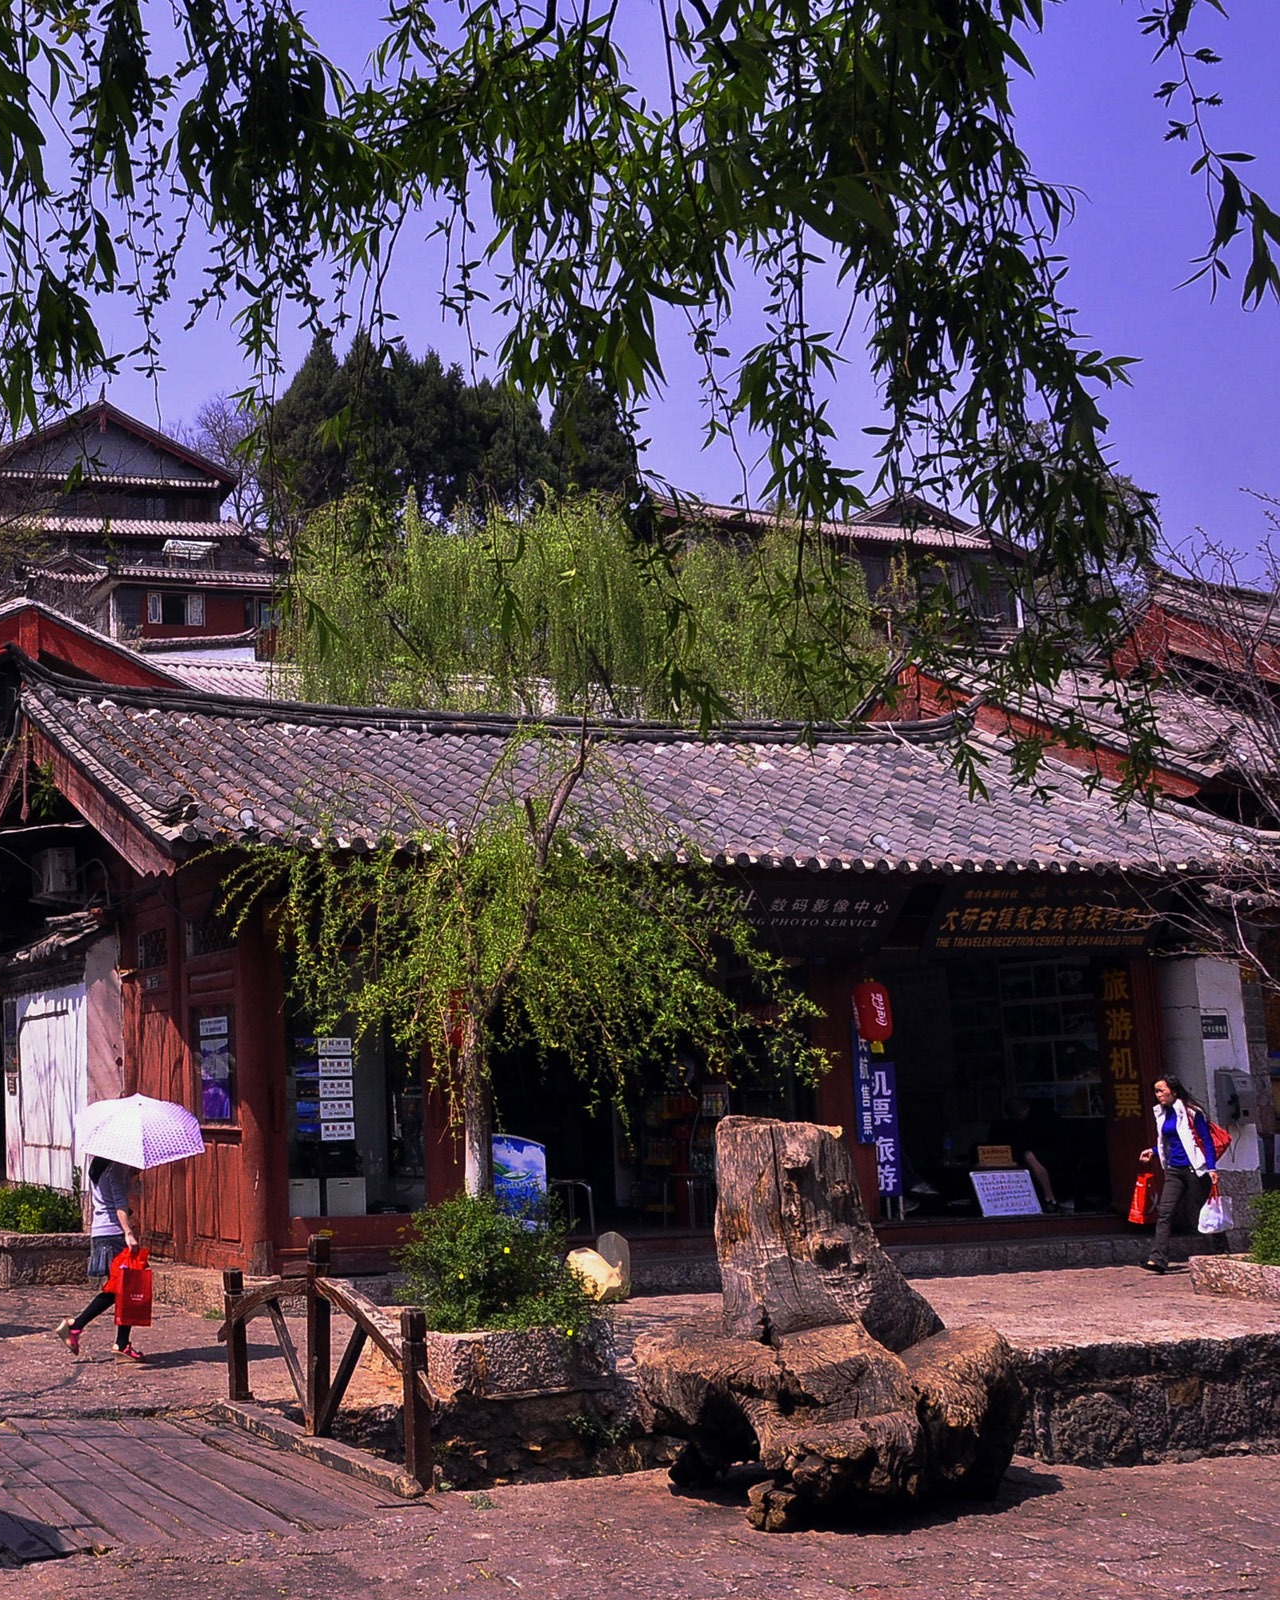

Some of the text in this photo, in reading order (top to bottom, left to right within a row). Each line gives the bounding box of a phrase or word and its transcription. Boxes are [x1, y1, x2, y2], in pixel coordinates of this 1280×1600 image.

[769, 897, 889, 915] 数码影像中心
[770, 917, 820, 928] PHOTO
[823, 918, 880, 928] SERVICE
[935, 937, 951, 947] THE
[953, 937, 992, 947] TRAVELER
[992, 936, 1035, 947] RECEPTION
[1035, 936, 1065, 947] CENTER
[1066, 936, 1075, 947] OF
[1104, 936, 1120, 946] OLD
[1102, 968, 1142, 1118] 旅游机票
[871, 1071, 898, 1192] 机票 旅游
